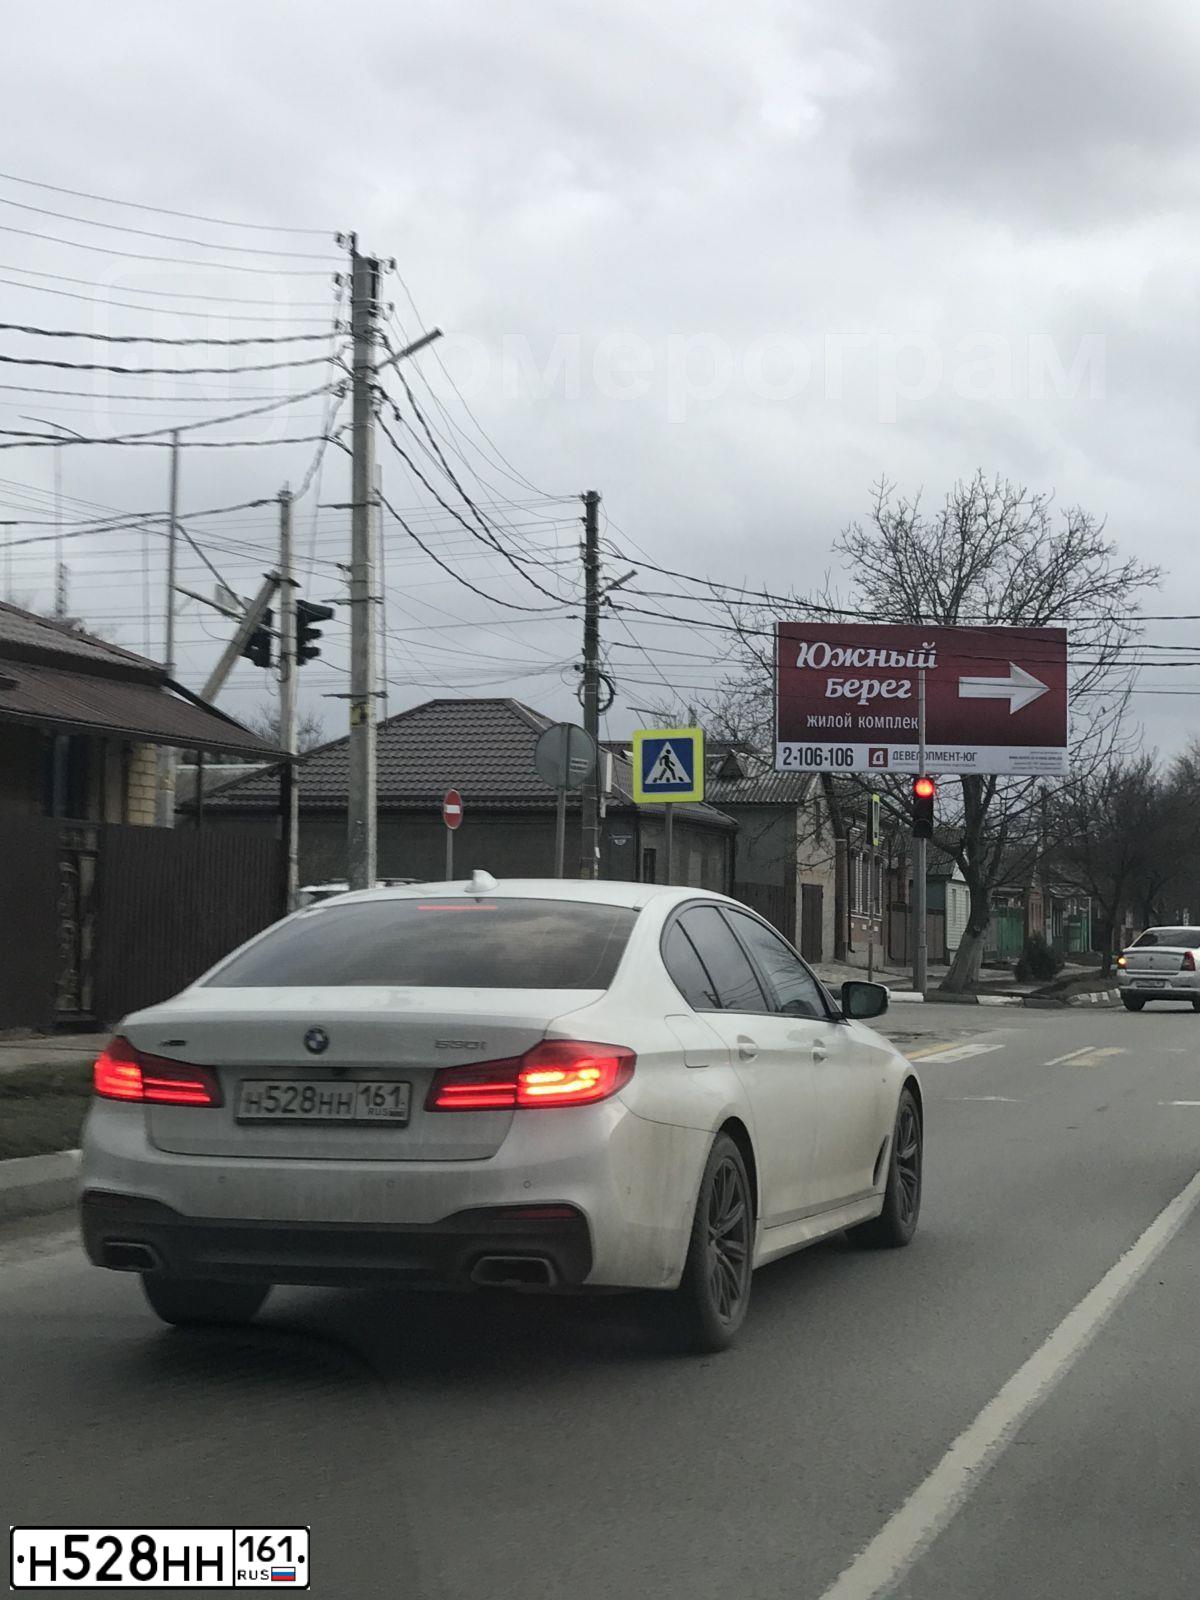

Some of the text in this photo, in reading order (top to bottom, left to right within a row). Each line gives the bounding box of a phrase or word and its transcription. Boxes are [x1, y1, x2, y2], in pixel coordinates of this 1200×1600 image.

[796, 641, 938, 669] Южный
[824, 678, 912, 705] Берег
[806, 712, 920, 729] жилой комплек
[359, 1085, 401, 1108] 161
